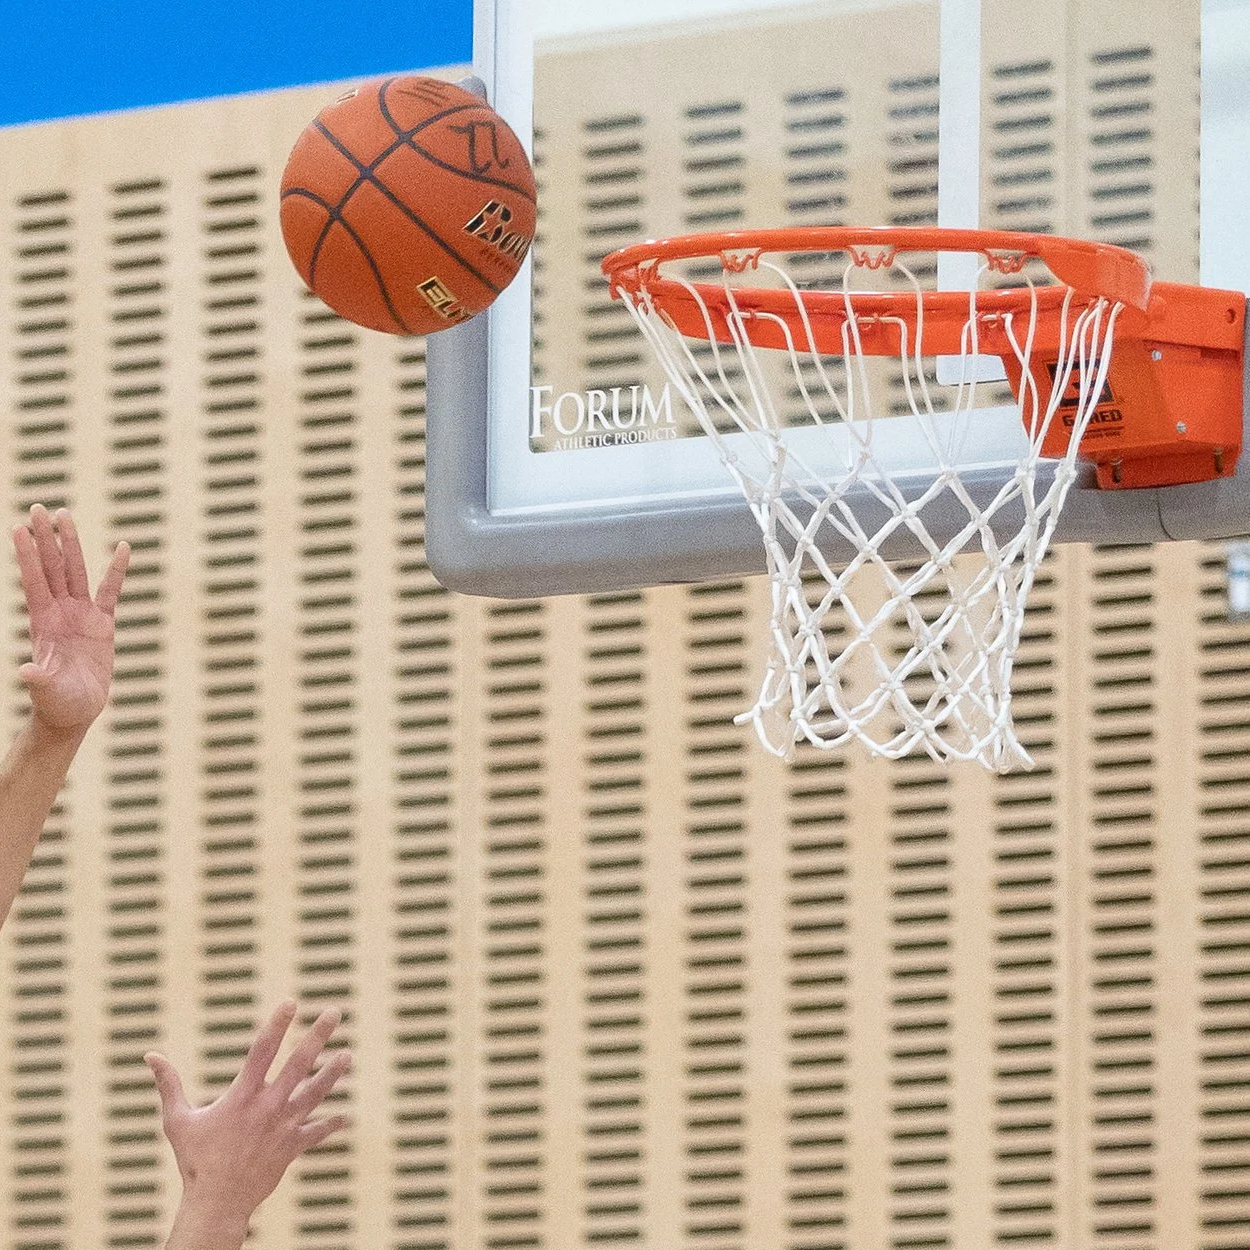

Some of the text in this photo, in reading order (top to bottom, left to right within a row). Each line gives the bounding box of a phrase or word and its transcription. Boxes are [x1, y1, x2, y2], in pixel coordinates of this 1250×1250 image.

[530, 383, 675, 437] FORUM
[555, 427, 677, 450] ATHLETIC PRODUCTS
